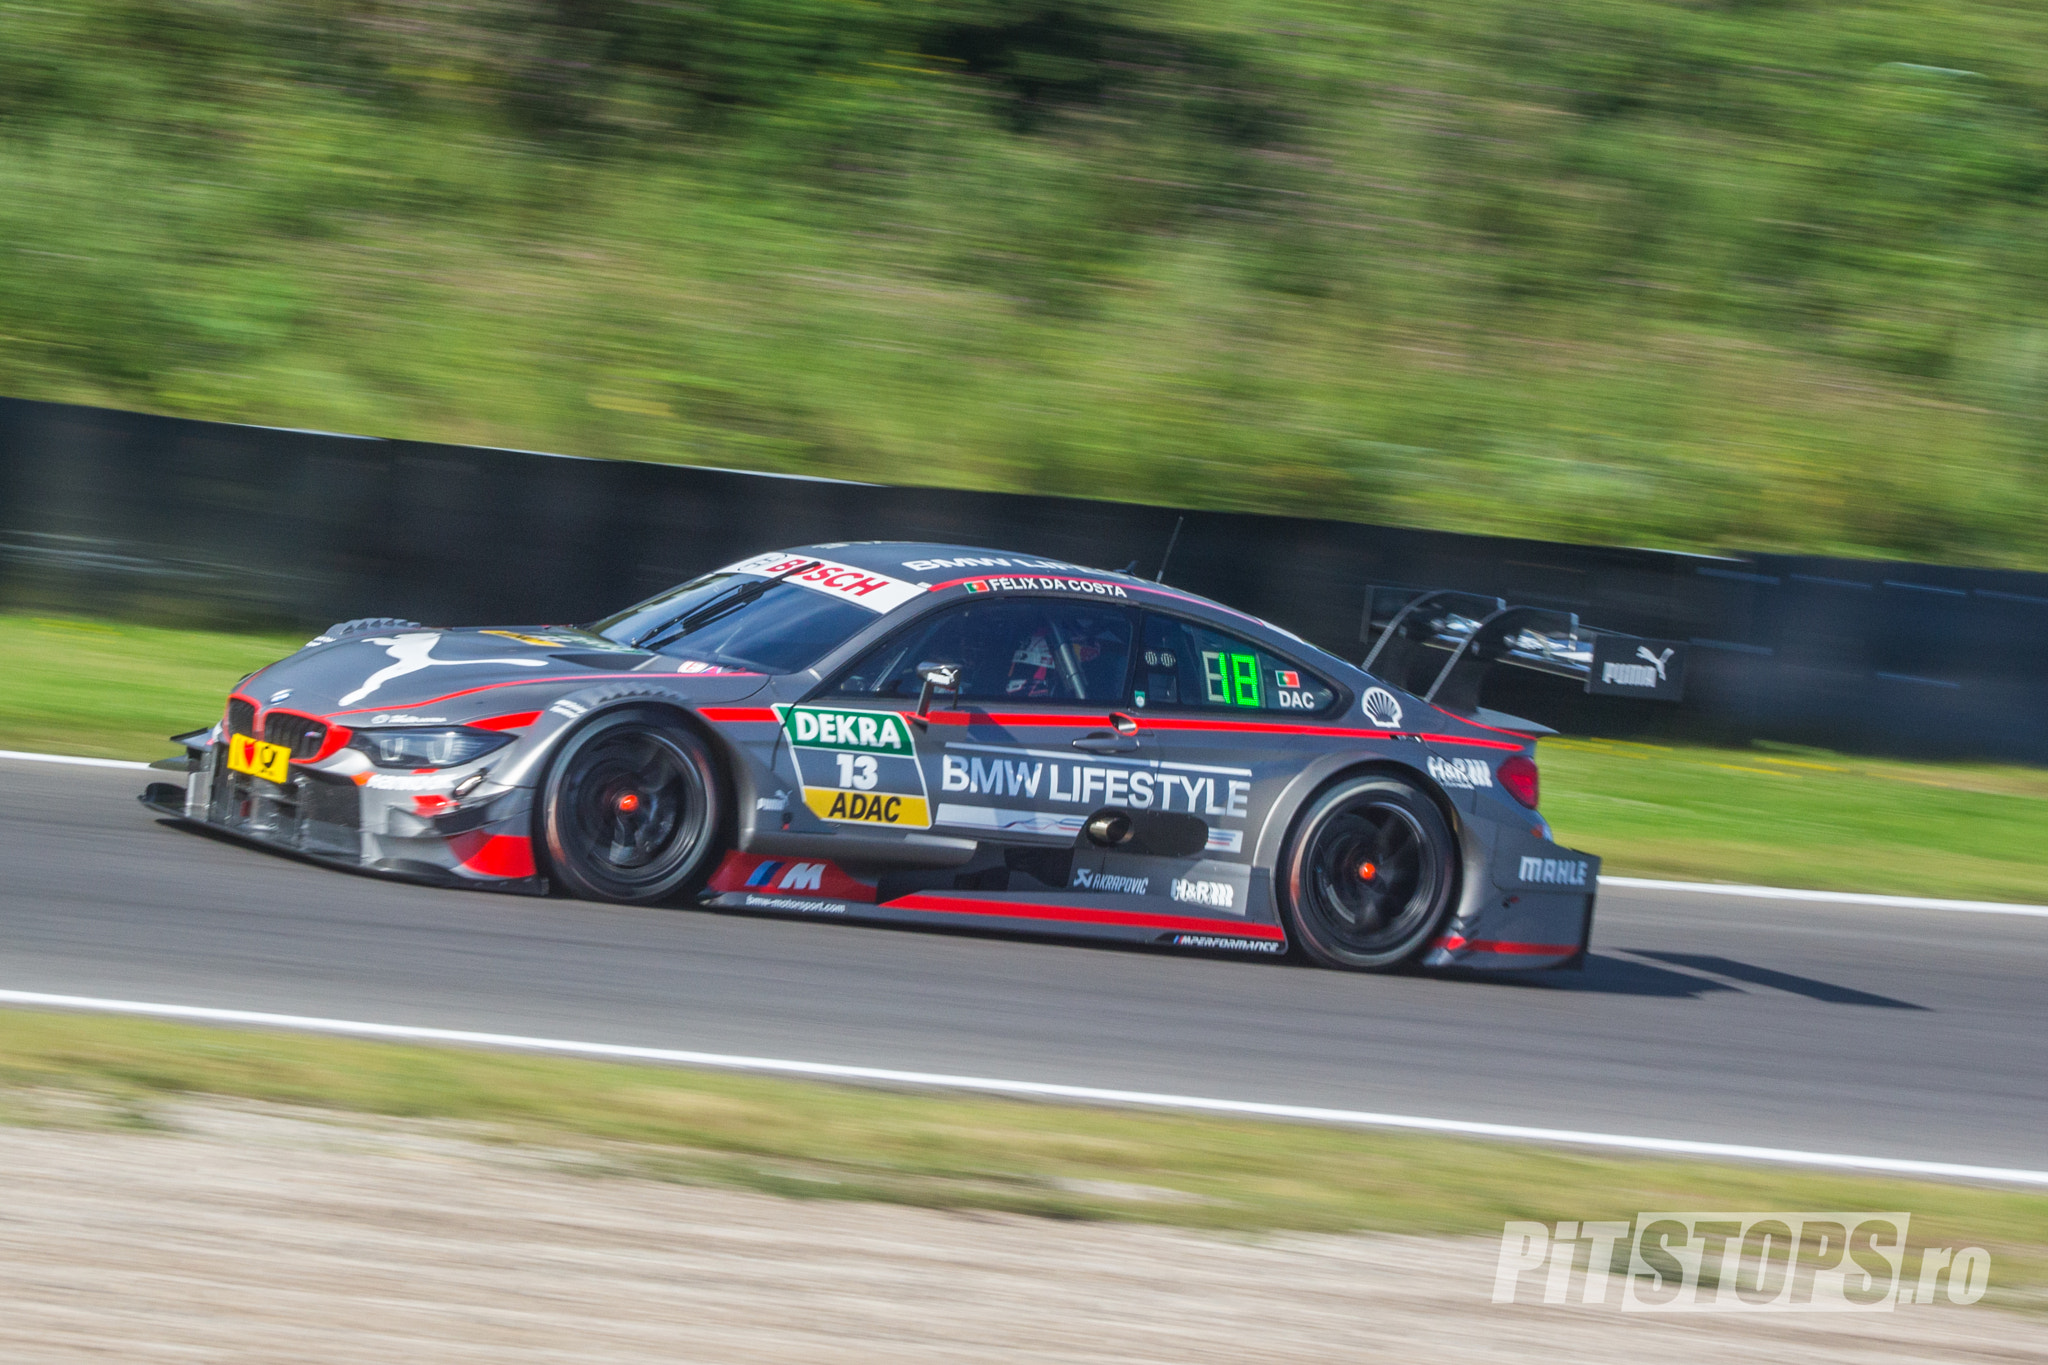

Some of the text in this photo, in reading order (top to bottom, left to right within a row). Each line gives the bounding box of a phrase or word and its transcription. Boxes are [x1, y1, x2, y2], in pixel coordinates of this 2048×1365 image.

[901, 557, 1012, 571] BMW
[1039, 577, 1067, 590] DA
[1067, 580, 1128, 598] COSTA
[1278, 690, 1316, 709] DAC
[795, 711, 902, 749] DEKRA
[836, 753, 879, 790] 13
[942, 754, 1251, 818] BMW LIFESTYLE
[828, 792, 902, 822] ADAC
[1518, 856, 1588, 885] MAHLE
